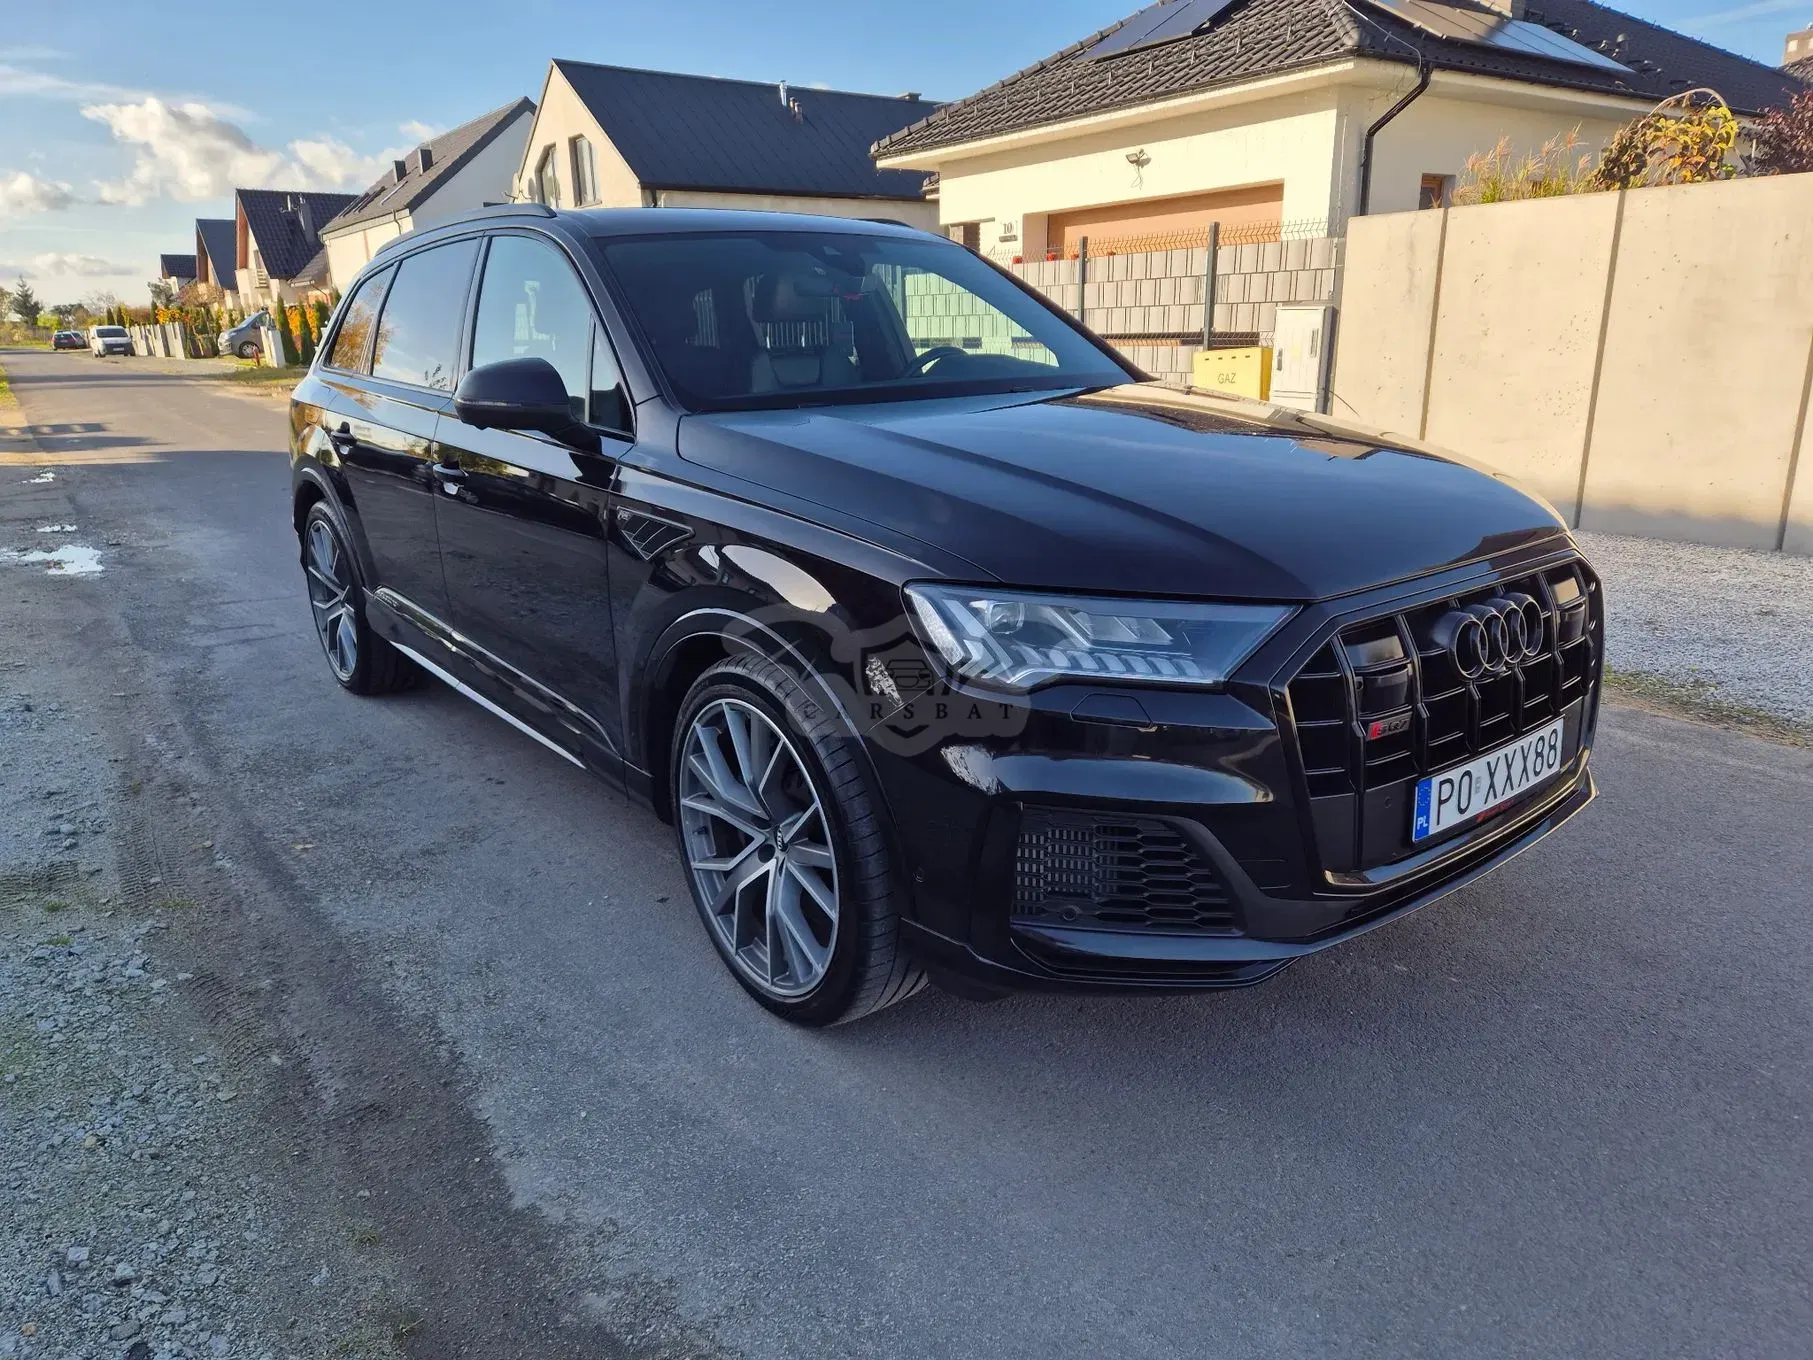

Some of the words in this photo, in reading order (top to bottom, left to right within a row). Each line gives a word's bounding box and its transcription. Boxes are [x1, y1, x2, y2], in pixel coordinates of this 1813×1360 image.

[1217, 373, 1236, 384] GAZ
[1485, 728, 1558, 804] XXX88
[1416, 816, 1428, 830] PL
